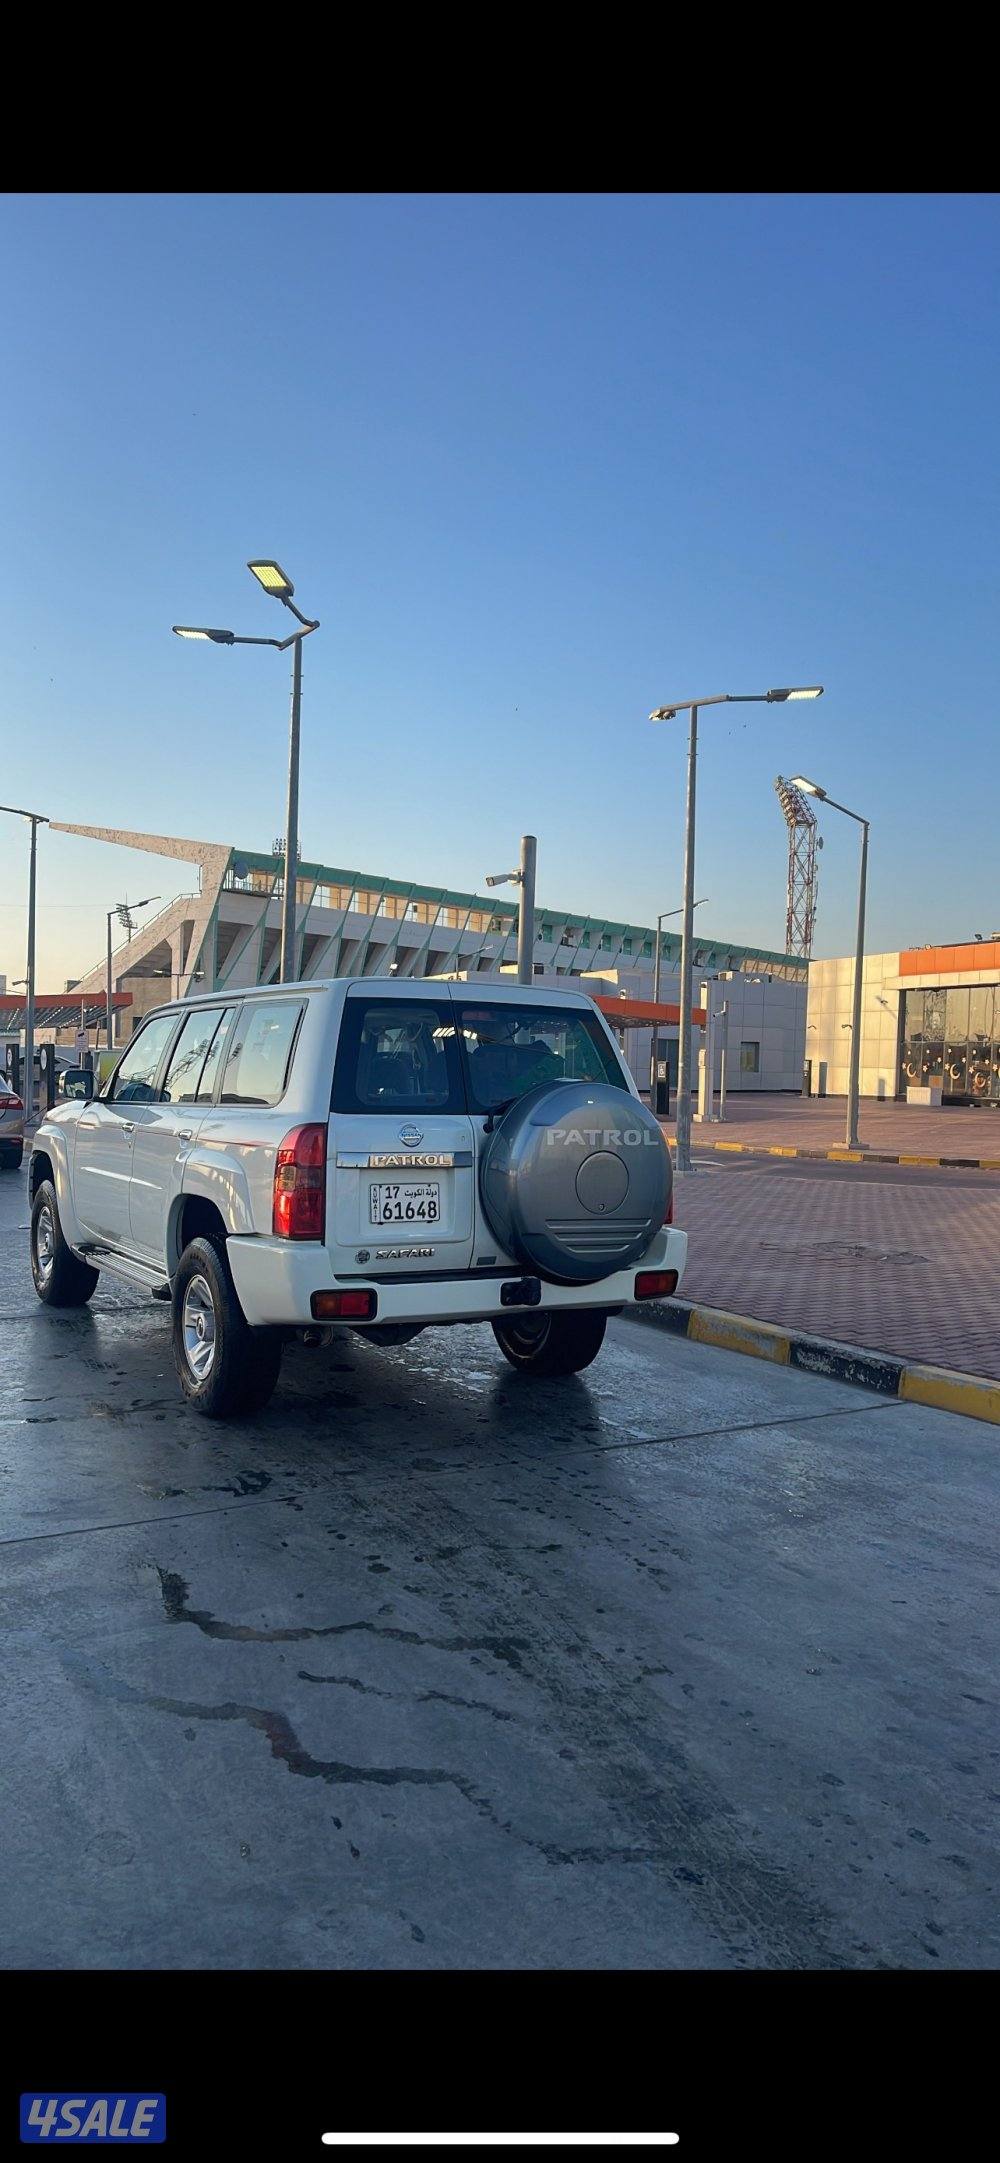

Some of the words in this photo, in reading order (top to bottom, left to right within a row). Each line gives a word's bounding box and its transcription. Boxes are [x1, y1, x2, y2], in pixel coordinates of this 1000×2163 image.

[546, 1129, 659, 1147] PATROL
[374, 1155, 453, 1166] PATROL
[385, 1186, 400, 1199] 17
[404, 1189, 425, 1198] الكويت
[425, 1189, 437, 1198] دولة
[383, 1201, 437, 1220] 61648
[375, 1248, 435, 1259] SAFARI
